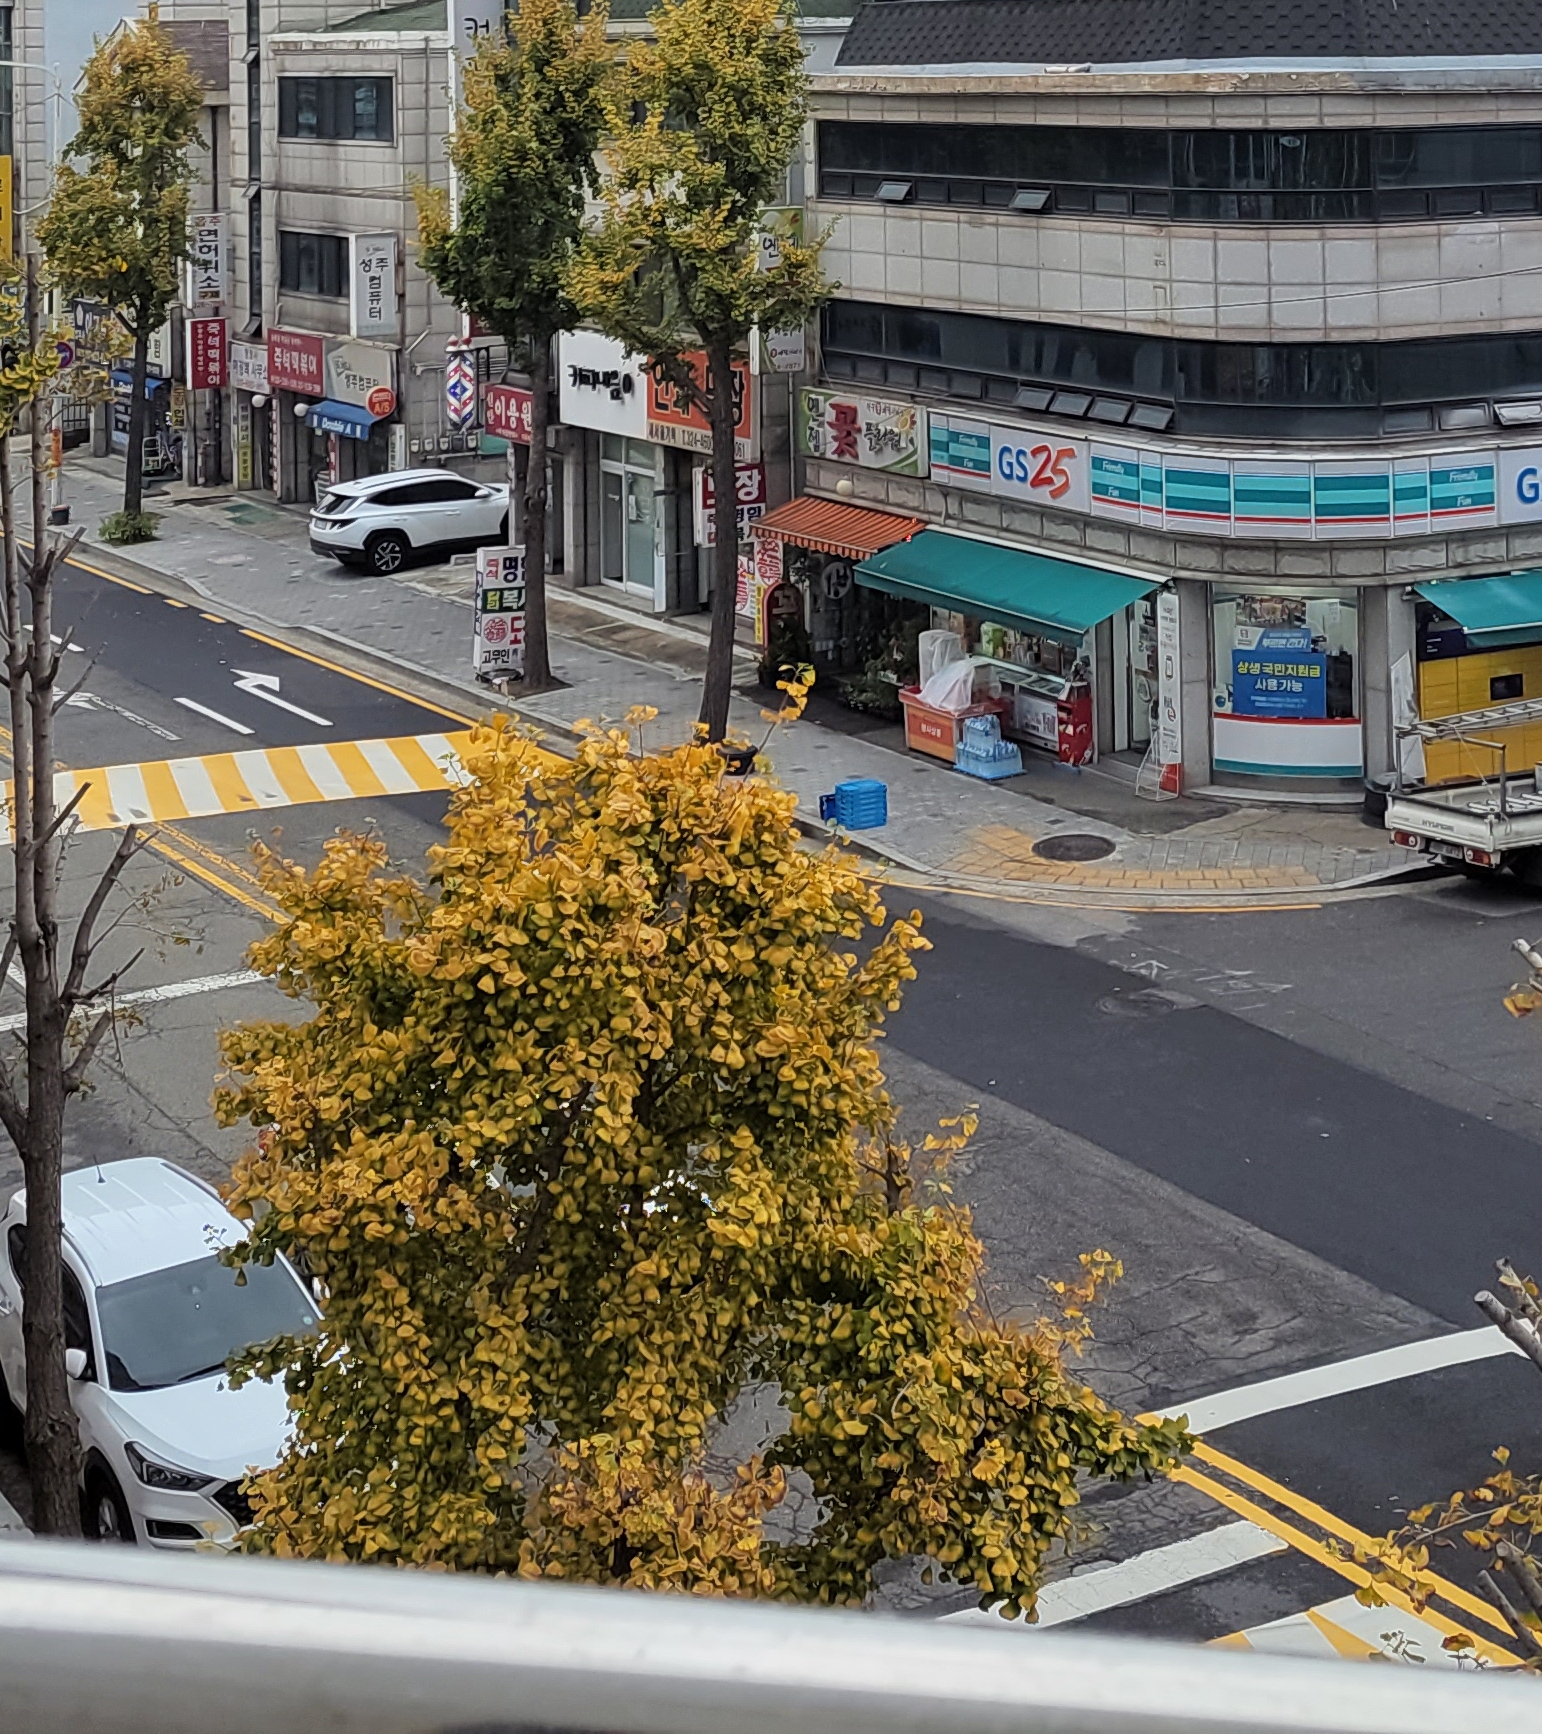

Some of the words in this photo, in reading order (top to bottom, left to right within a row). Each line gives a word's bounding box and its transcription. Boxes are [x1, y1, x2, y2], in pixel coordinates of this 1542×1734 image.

[368, 275, 382, 321] 컴퓨터
[344, 422, 352, 435] A
[495, 395, 532, 431] 이용원
[827, 402, 860, 458] 꽃
[998, 443, 1077, 499] GS25
